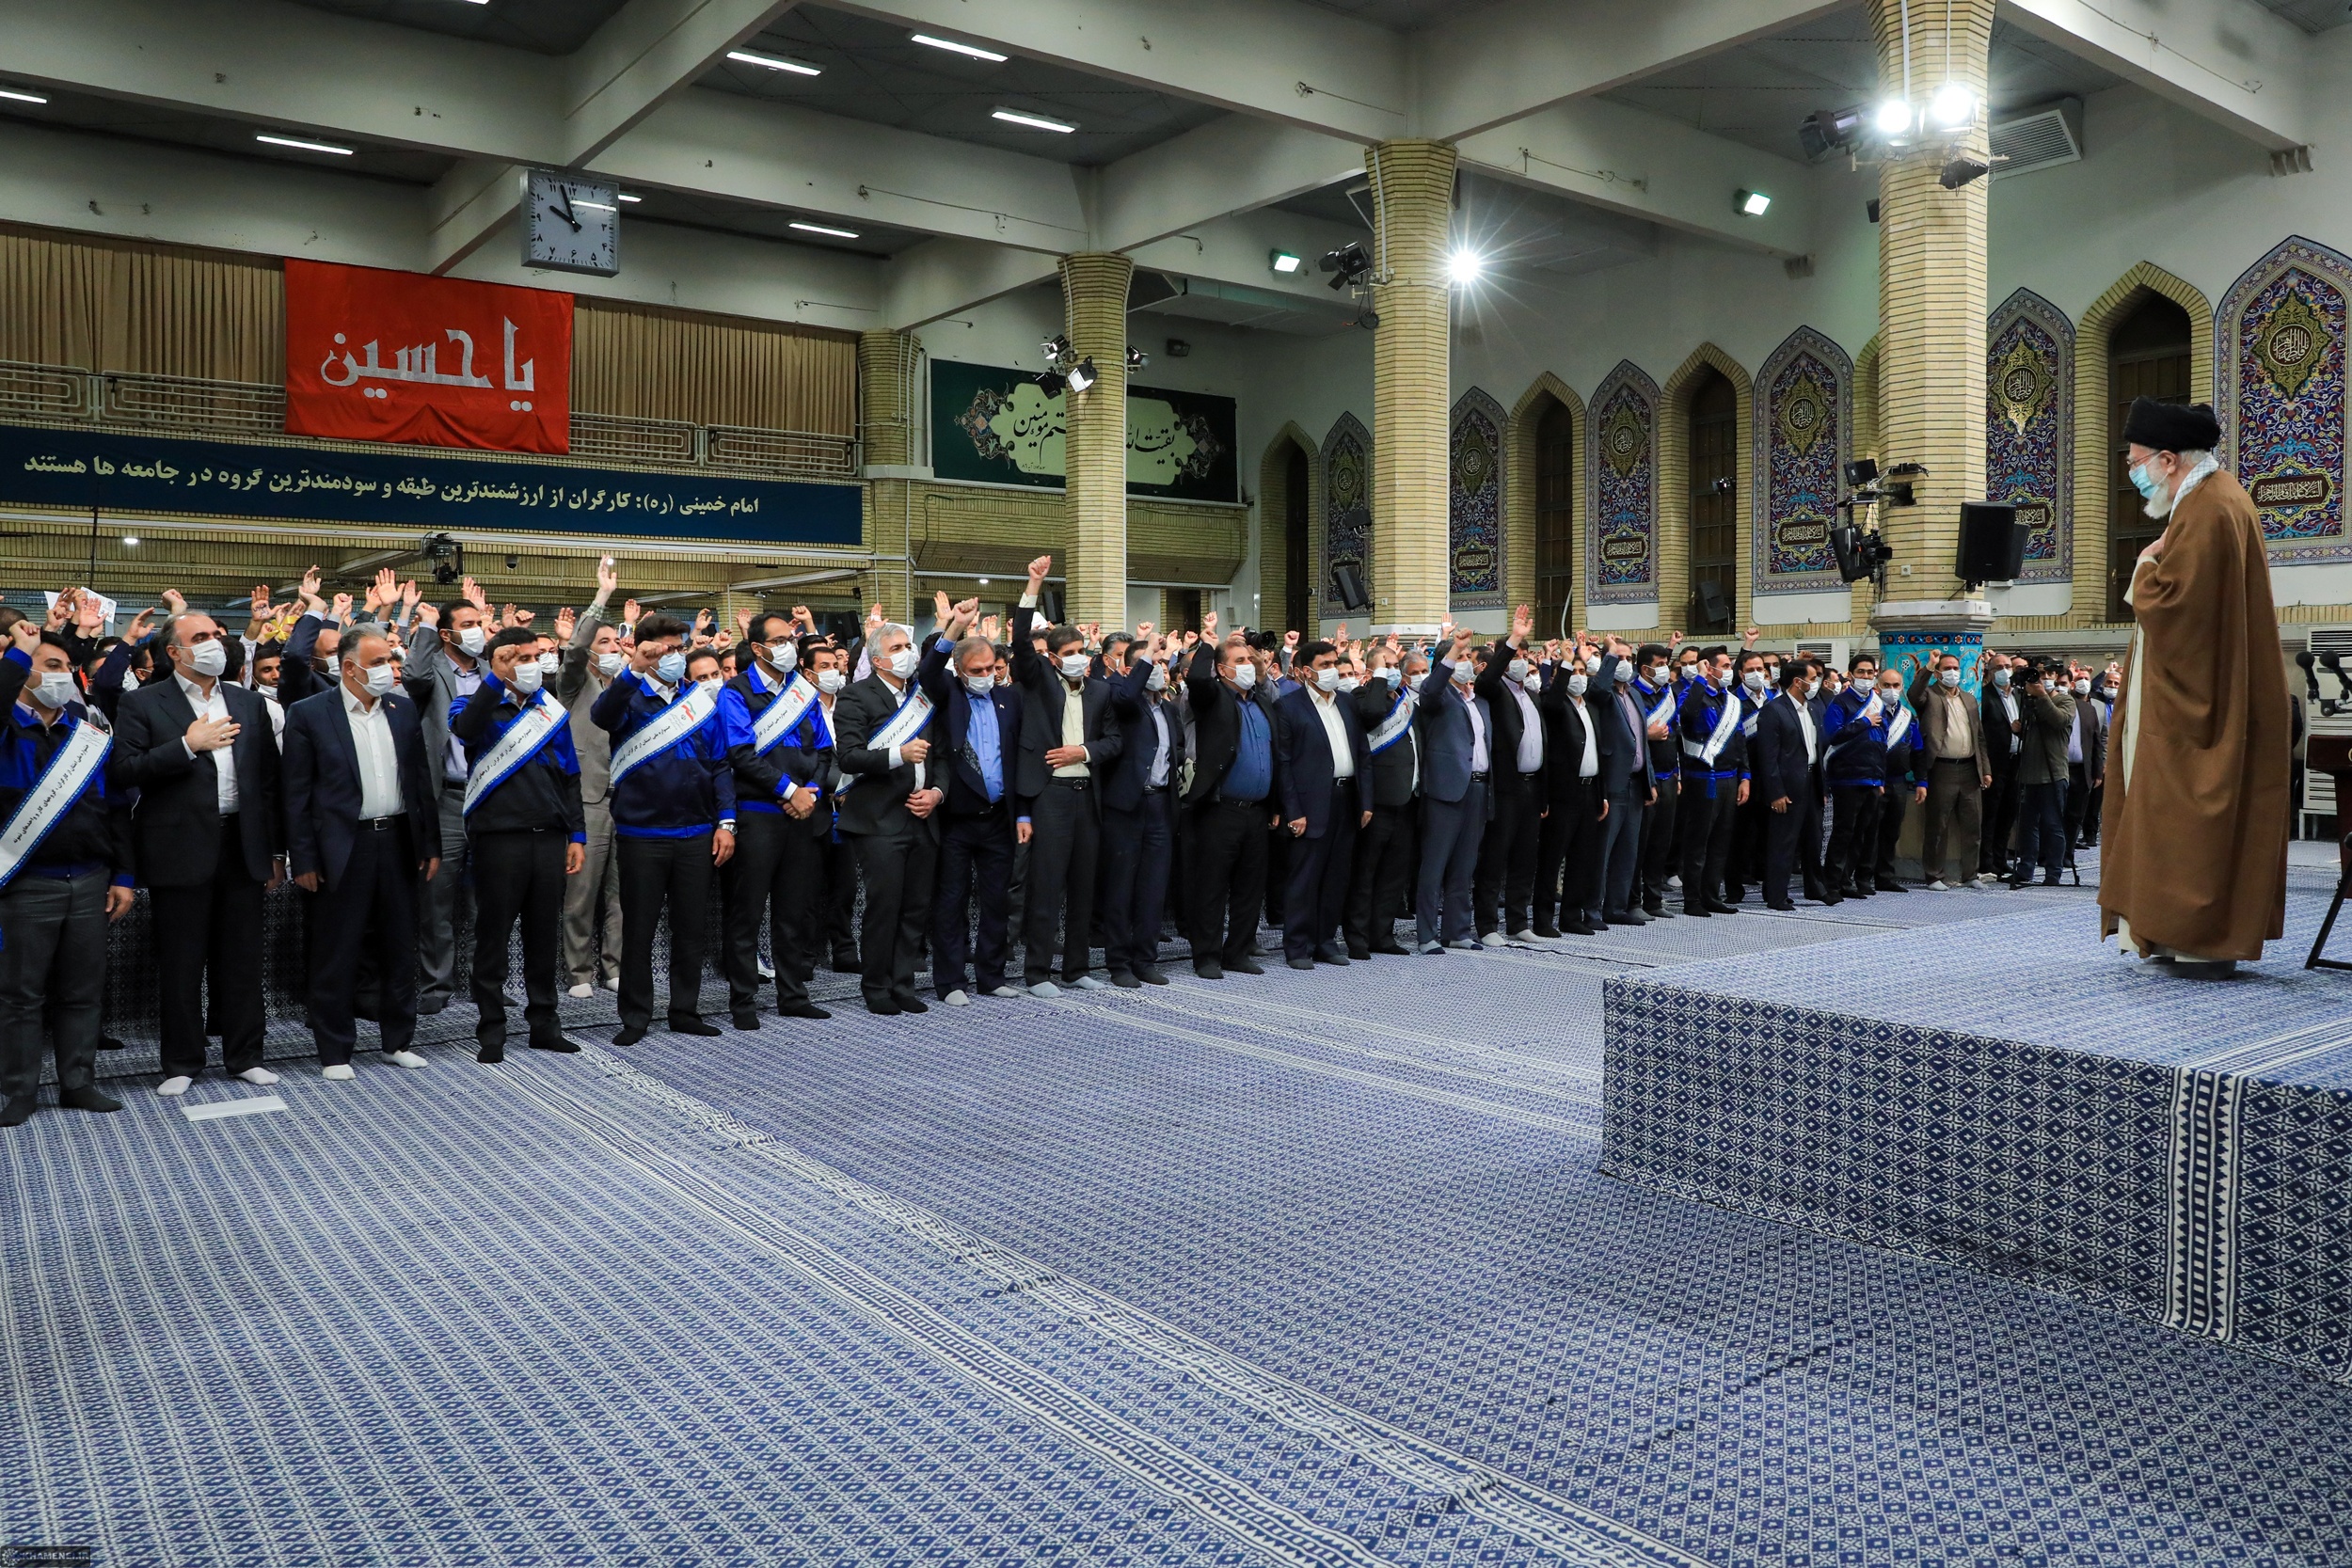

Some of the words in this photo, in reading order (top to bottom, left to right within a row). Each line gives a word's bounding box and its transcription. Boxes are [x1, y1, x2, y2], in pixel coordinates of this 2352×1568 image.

[549, 246, 556, 255] ۷
[321, 329, 495, 399] حسین
[504, 315, 535, 412] یا
[24, 455, 87, 474] هستند
[93, 455, 115, 475] ها
[121, 460, 180, 485] جامعه
[187, 467, 213, 486] در
[218, 468, 263, 491] گروه
[269, 470, 377, 497] سودمندترین
[381, 483, 392, 499] و
[397, 478, 436, 499] طبقه
[441, 482, 544, 506] ارزشمندترین
[549, 486, 564, 508] از
[569, 487, 631, 512] کارگران
[679, 496, 726, 515] خمینی
[731, 497, 759, 517] امام
